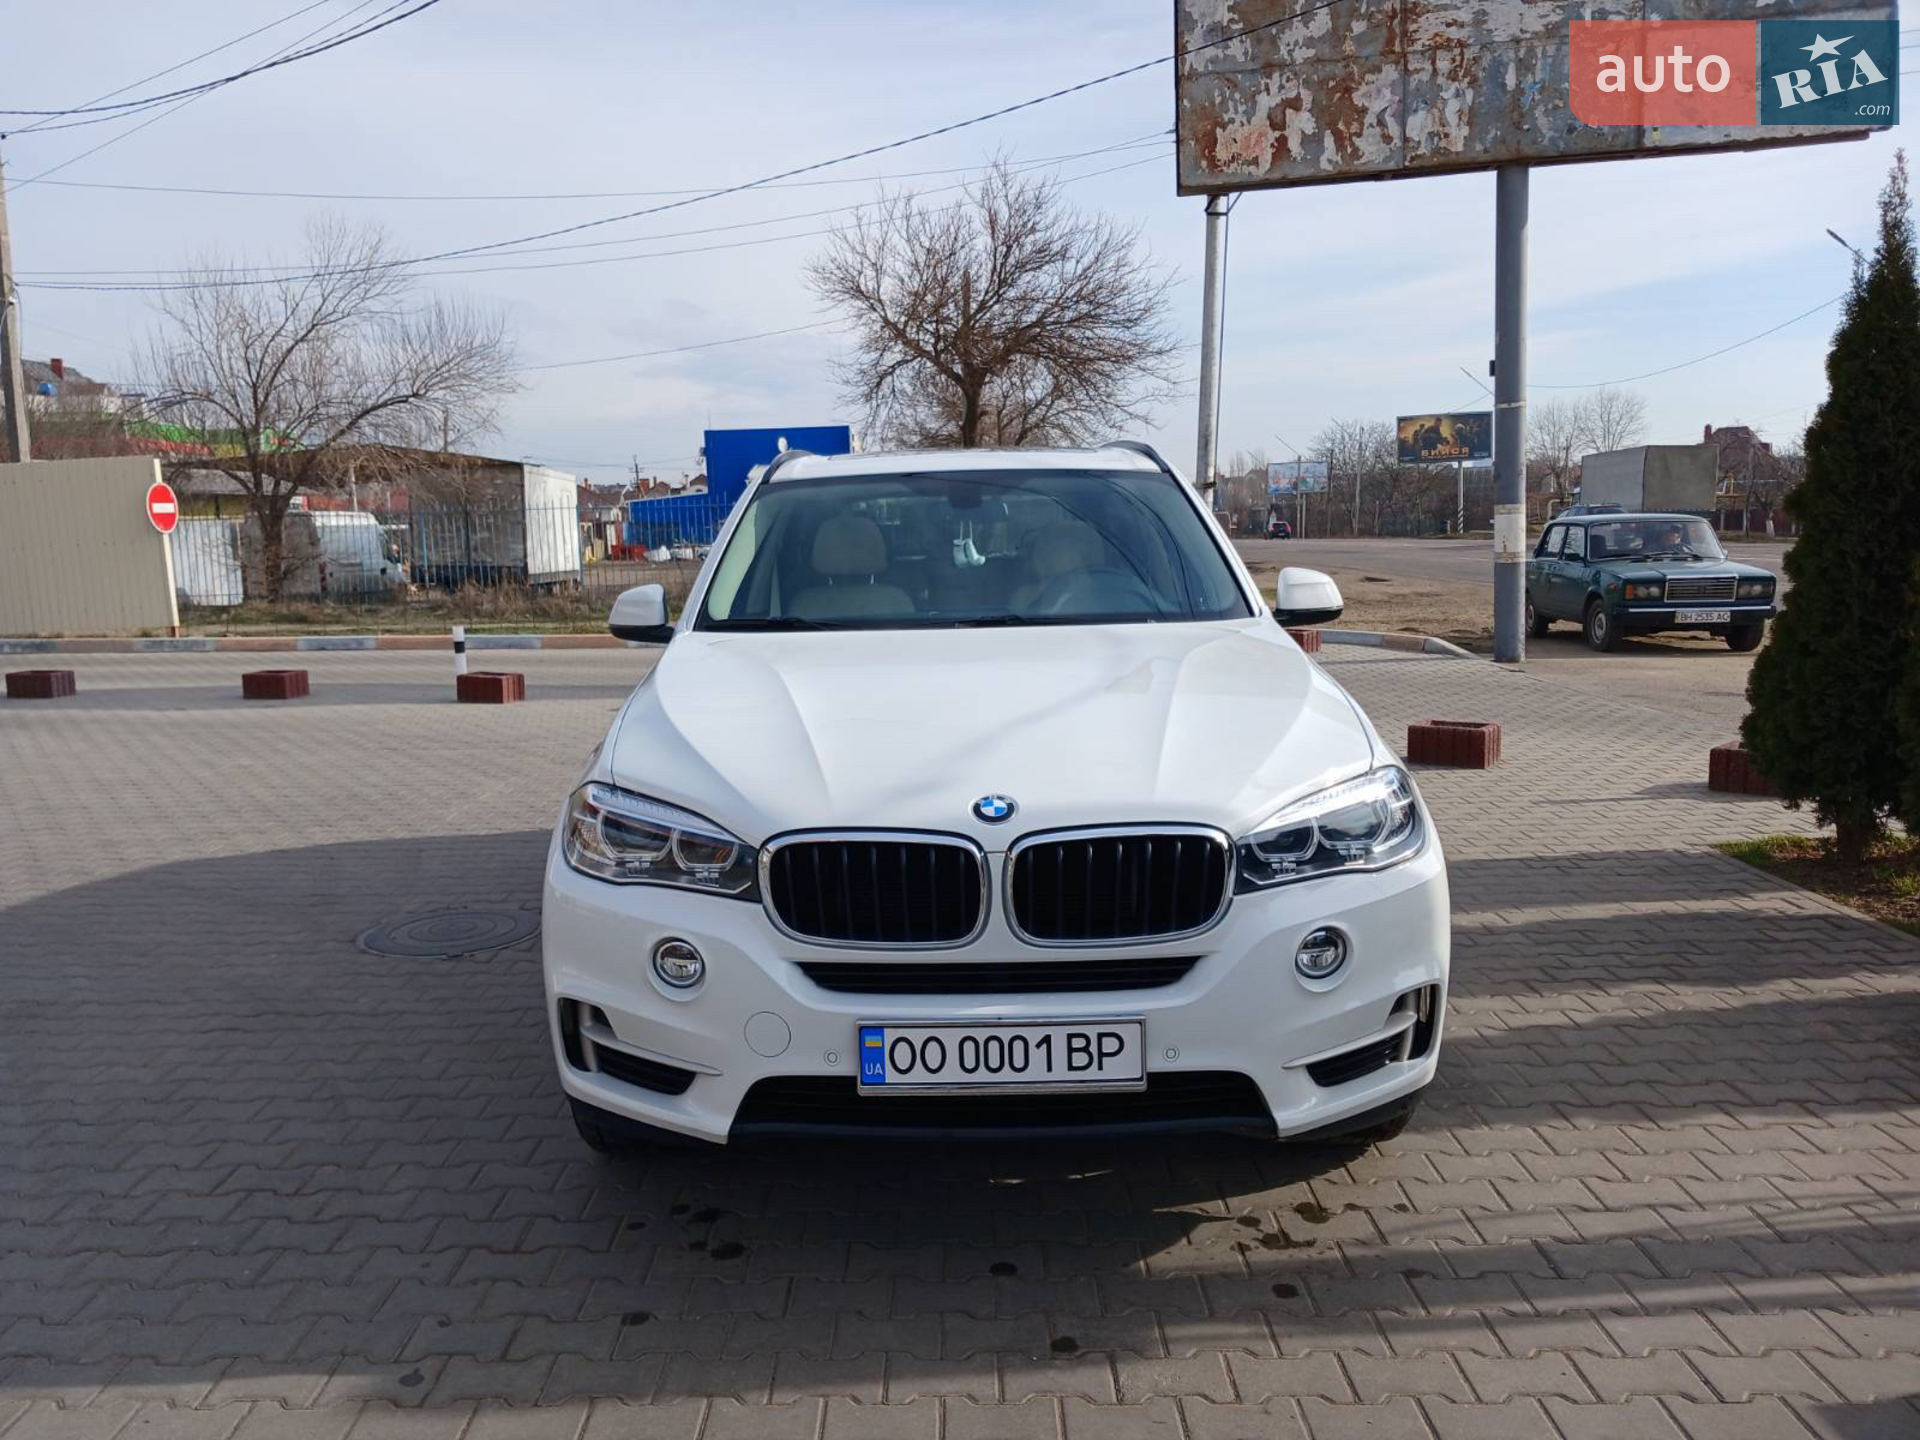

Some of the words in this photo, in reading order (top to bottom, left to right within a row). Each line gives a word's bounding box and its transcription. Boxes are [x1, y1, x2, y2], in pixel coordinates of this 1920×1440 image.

[958, 1034, 1053, 1075] 0001
[1066, 1031, 1125, 1072] BP
[865, 1063, 883, 1076] UA
